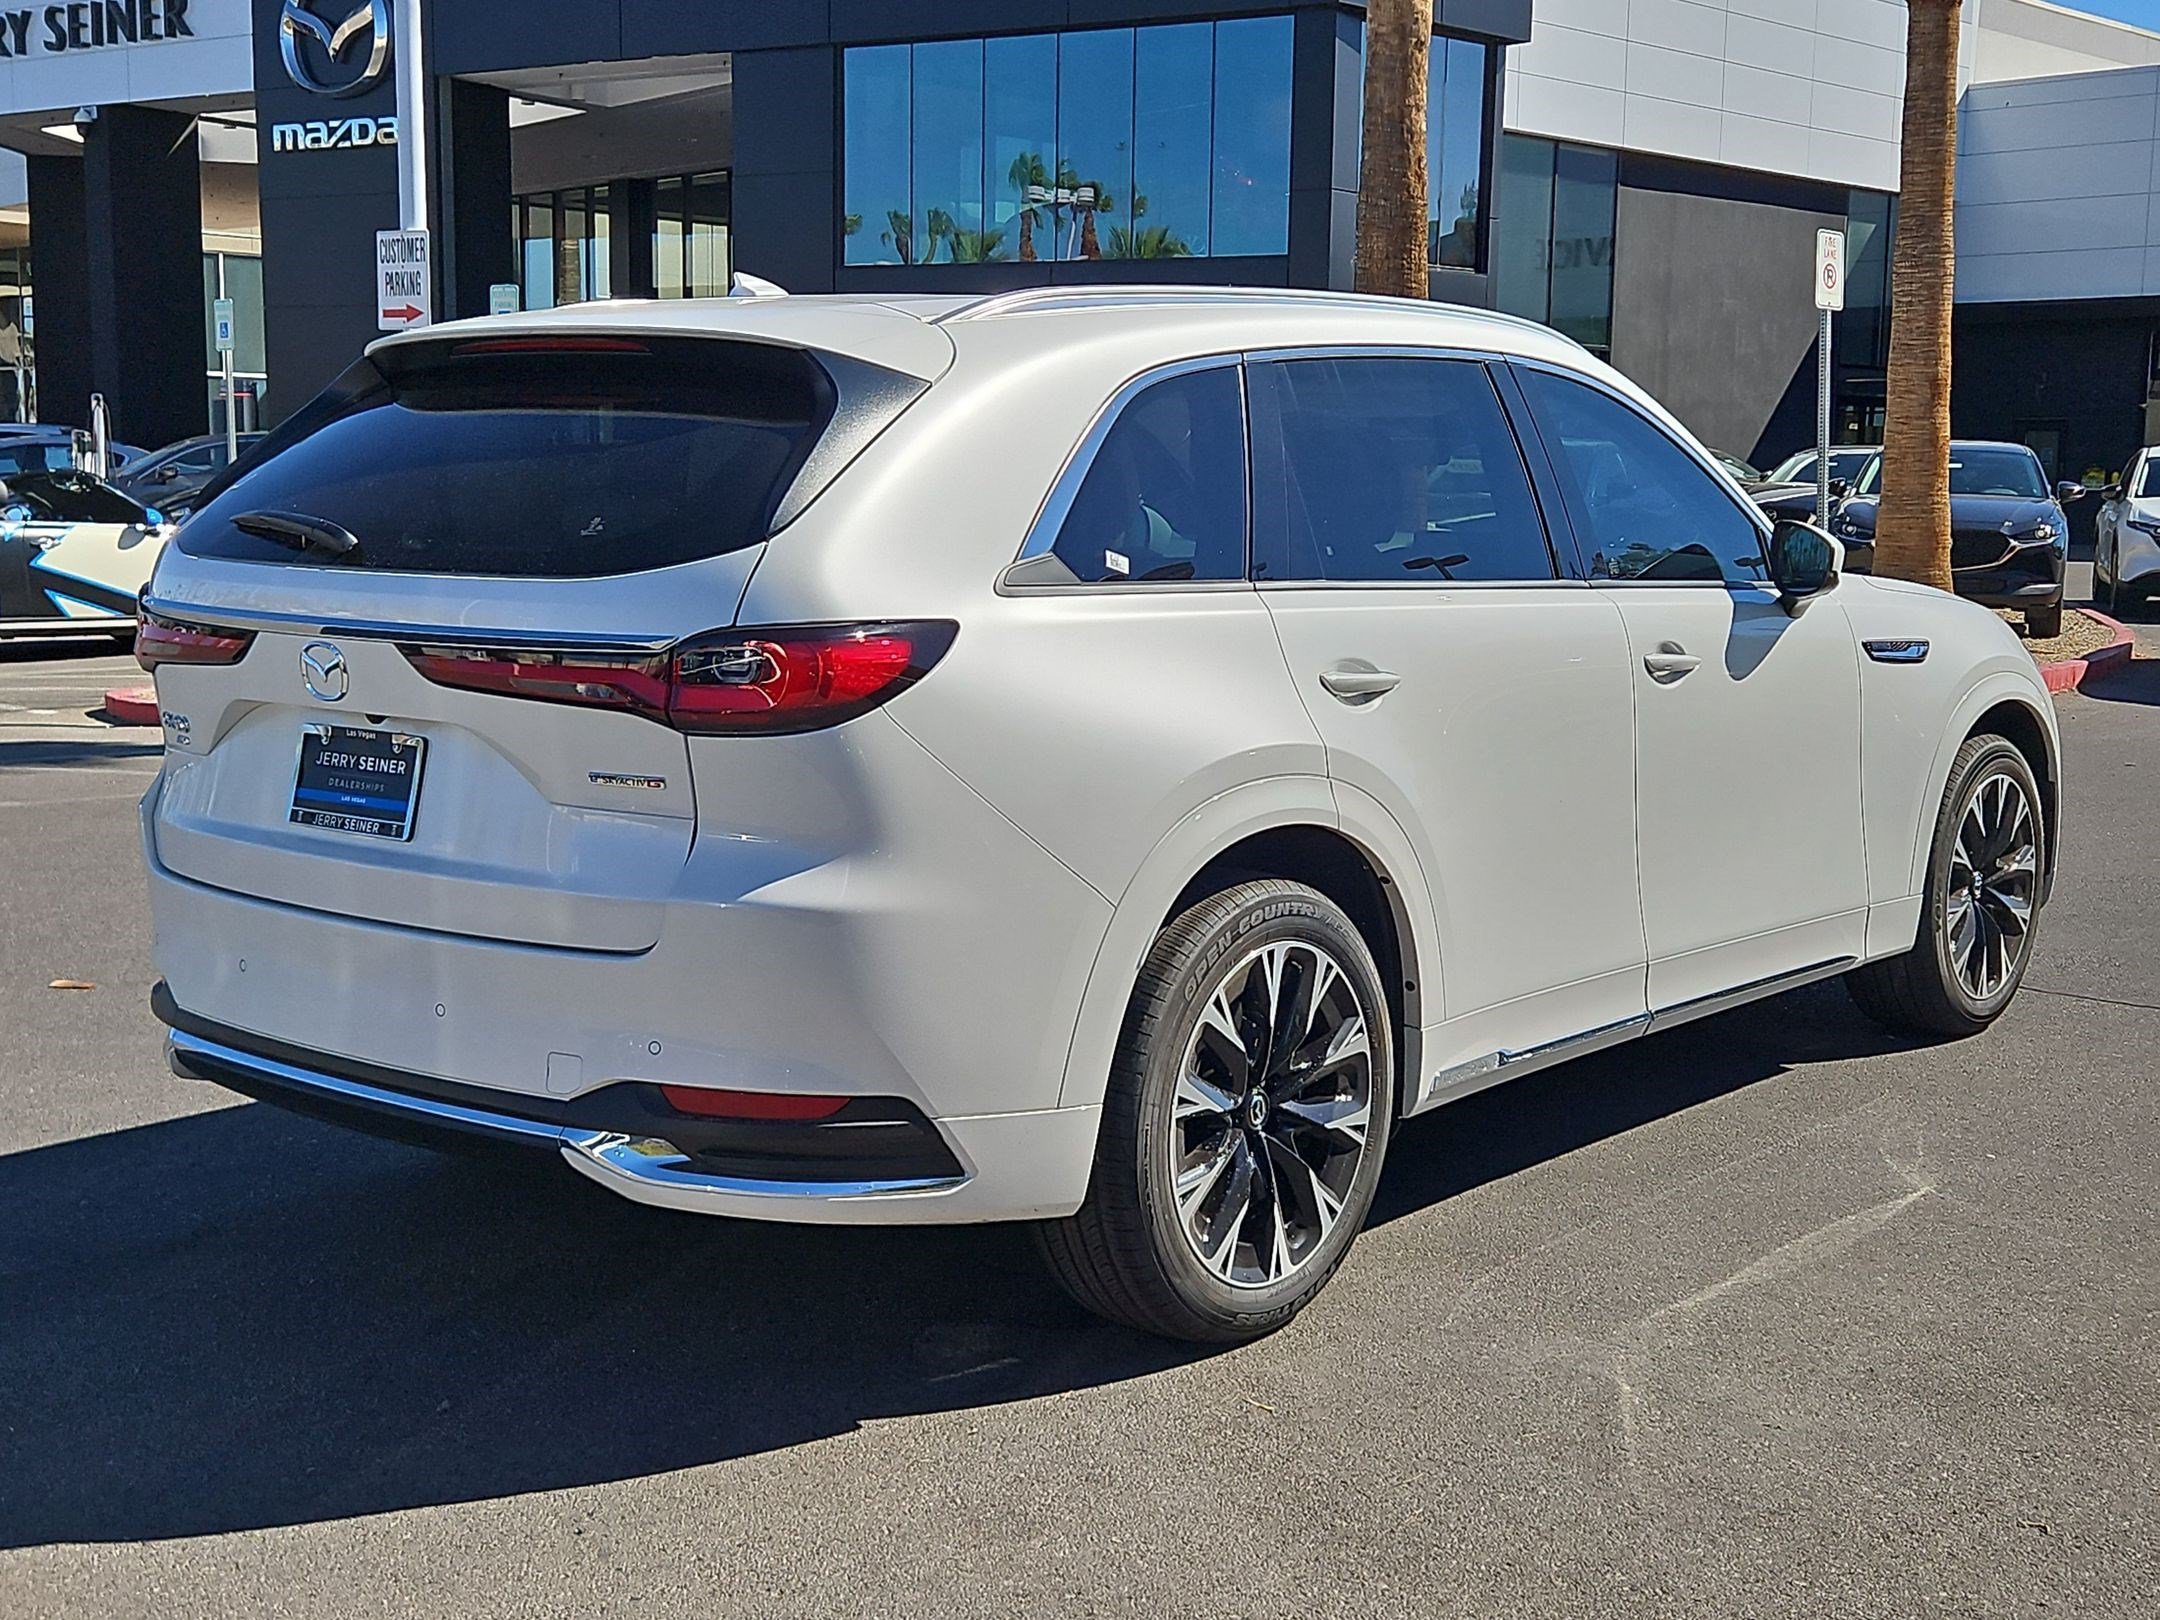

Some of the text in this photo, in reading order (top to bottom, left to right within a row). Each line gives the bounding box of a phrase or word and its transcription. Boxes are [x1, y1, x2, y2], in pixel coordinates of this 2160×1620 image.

[43, 0, 194, 51] SEINER
[380, 236, 426, 264] CUSTOMER
[385, 270, 421, 297] PARKING
[346, 729, 377, 740] Las Vegas
[315, 751, 407, 775] JERRY SEINER
[328, 777, 385, 792] DEALERSHIPS
[312, 813, 380, 834] JERRY SEINER
[1184, 935, 1232, 1001] OPEN
[1239, 901, 1322, 933] COUNTRY
